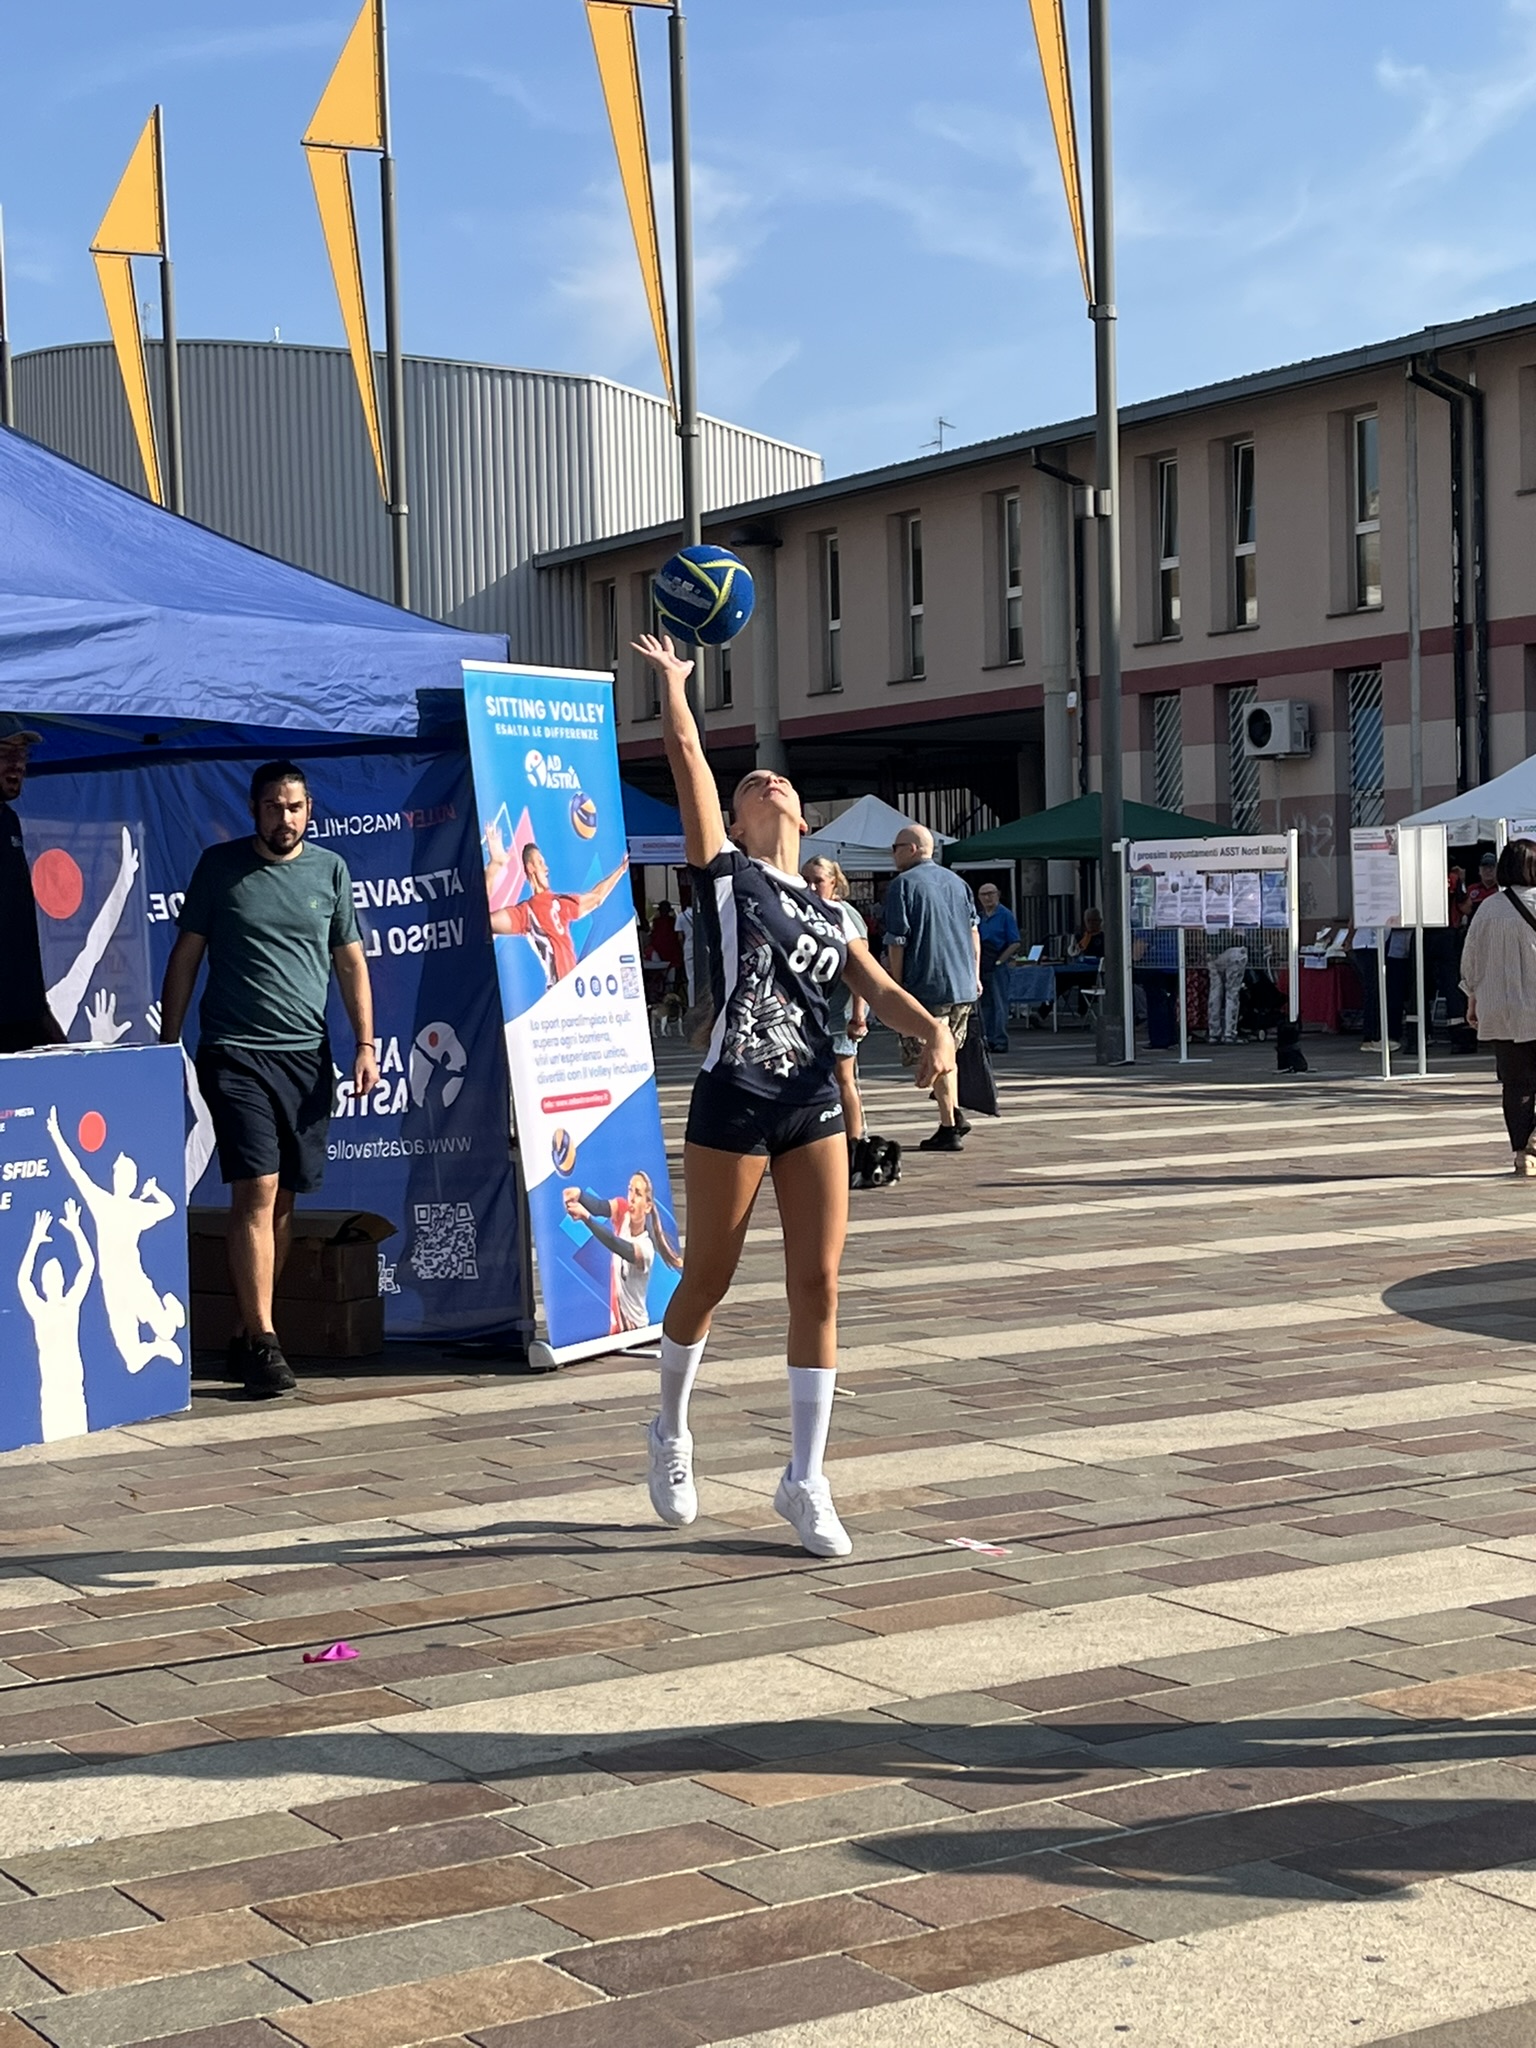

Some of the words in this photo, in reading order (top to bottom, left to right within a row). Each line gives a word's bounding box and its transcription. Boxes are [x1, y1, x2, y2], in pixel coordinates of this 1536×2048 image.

[485, 695, 546, 720] SITTING
[549, 700, 604, 723] VOLLEY
[495, 723, 530, 737] ESALTA
[532, 726, 542, 738] LE
[544, 726, 599, 741] DIFFERENZE
[547, 754, 562, 771] AD
[1137, 850, 1167, 862] prossimi
[1169, 848, 1218, 862] appuntamenti
[1219, 846, 1240, 857] ASST
[1241, 845, 1260, 856] Nord
[1261, 844, 1287, 855] Milano
[788, 933, 840, 983] 80
[2, 1158, 51, 1181] SFIDE,
